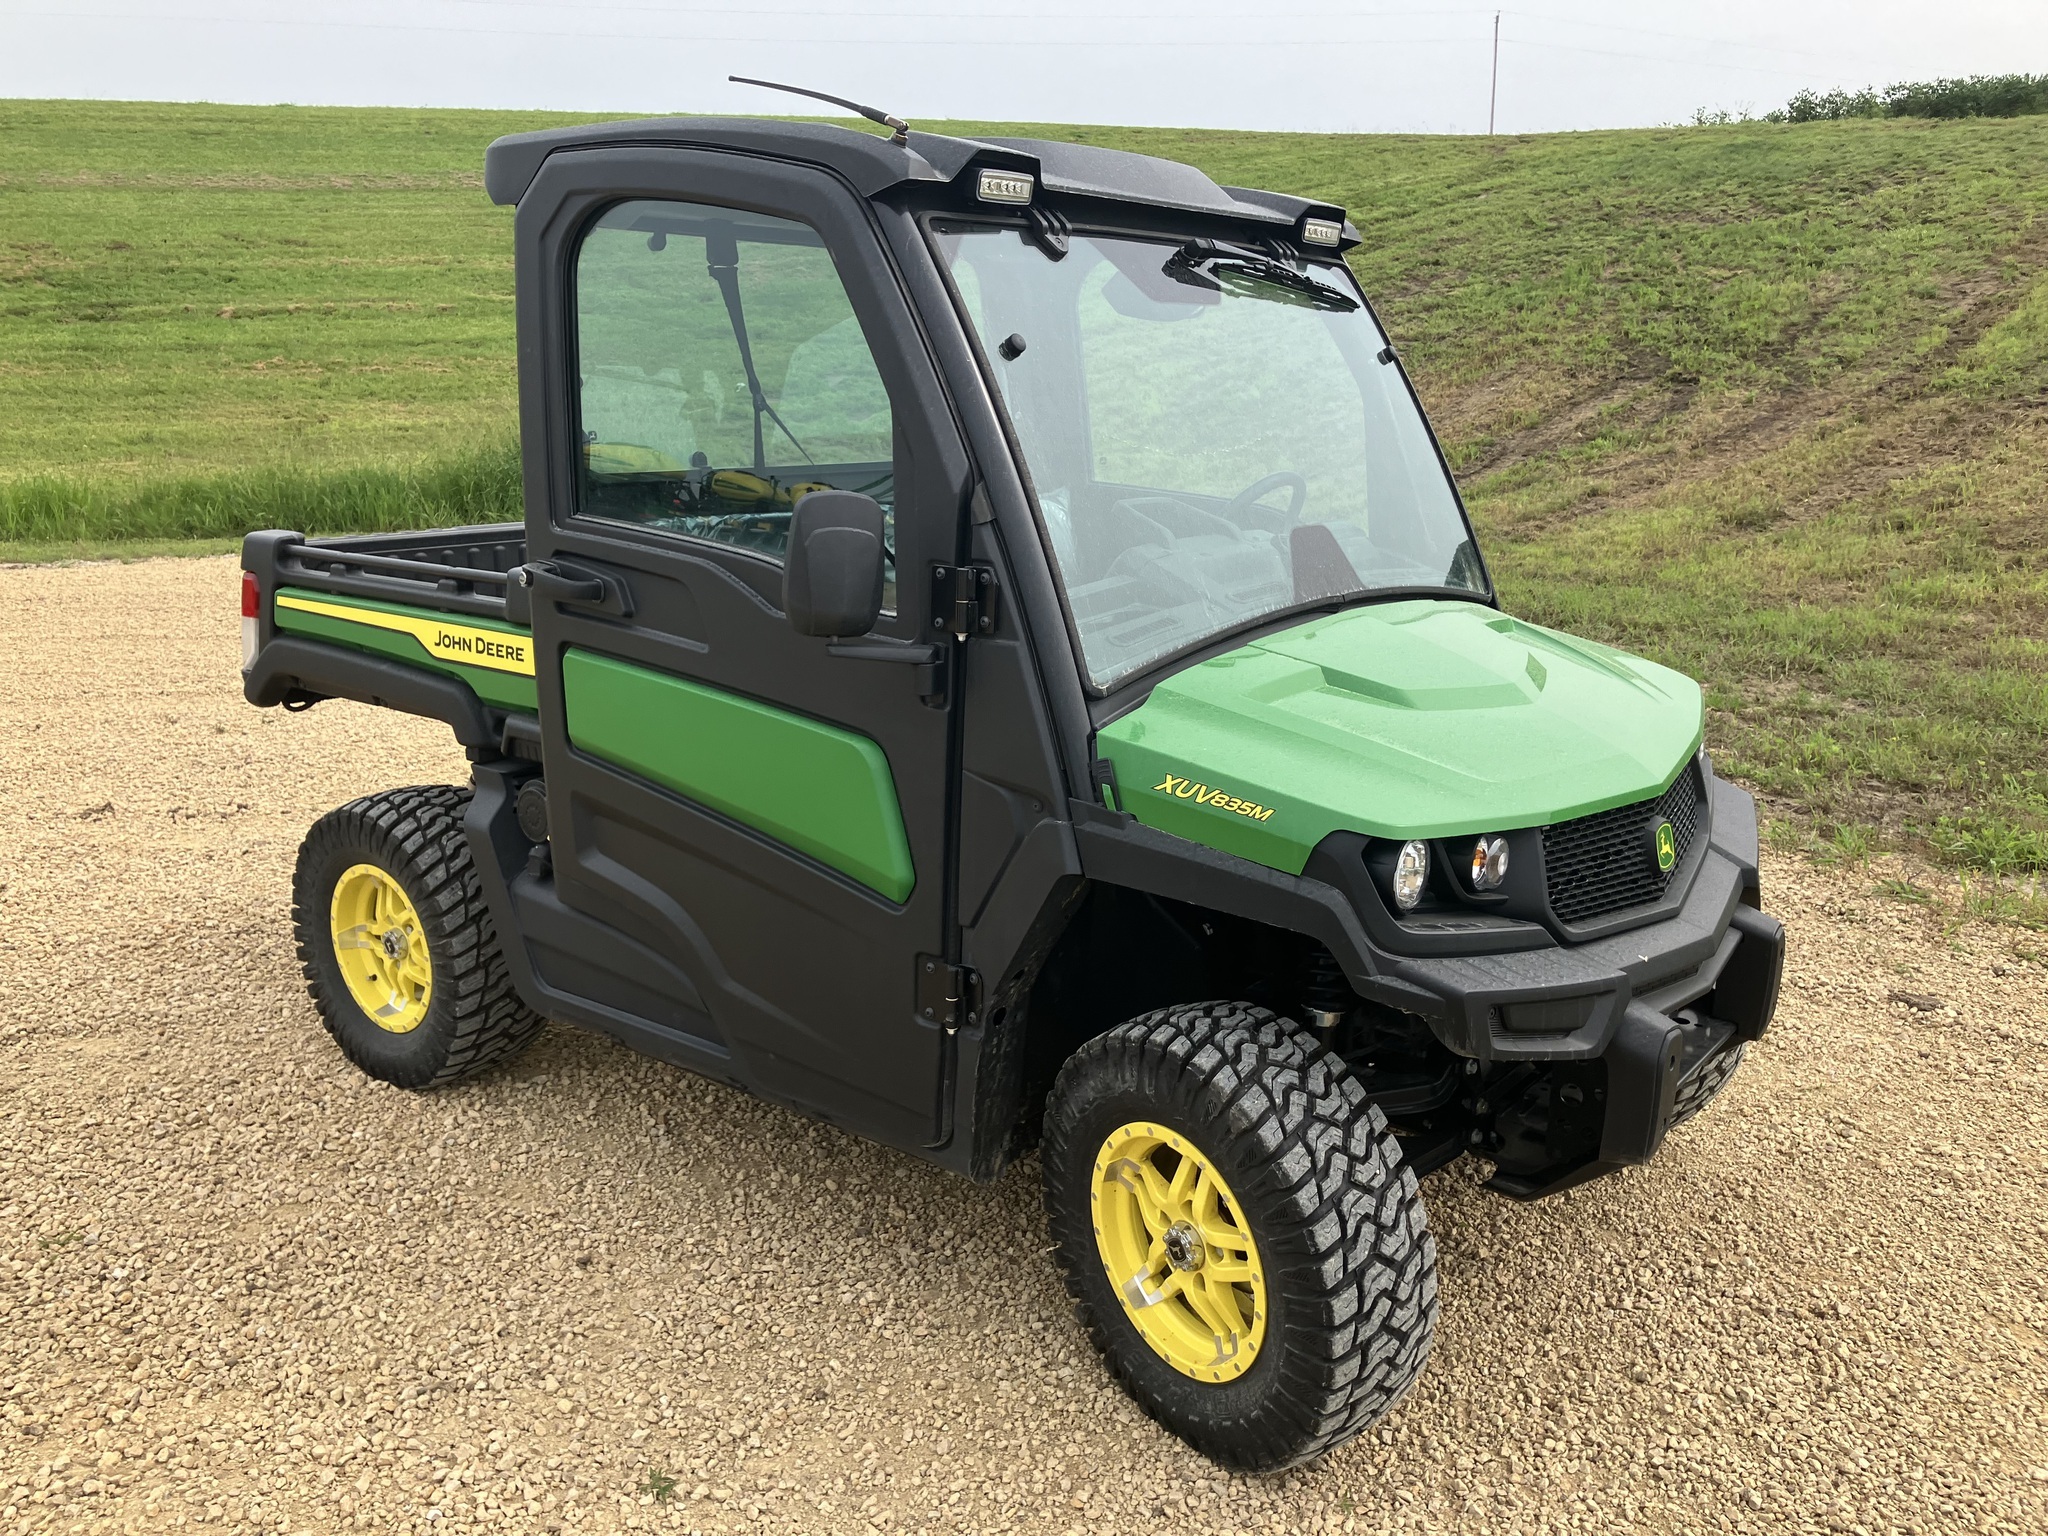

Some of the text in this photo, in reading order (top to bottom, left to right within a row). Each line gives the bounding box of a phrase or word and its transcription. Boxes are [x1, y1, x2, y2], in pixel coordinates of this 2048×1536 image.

[434, 630, 525, 662] JOHN DEERE
[1151, 773, 1276, 822] XUV835M
